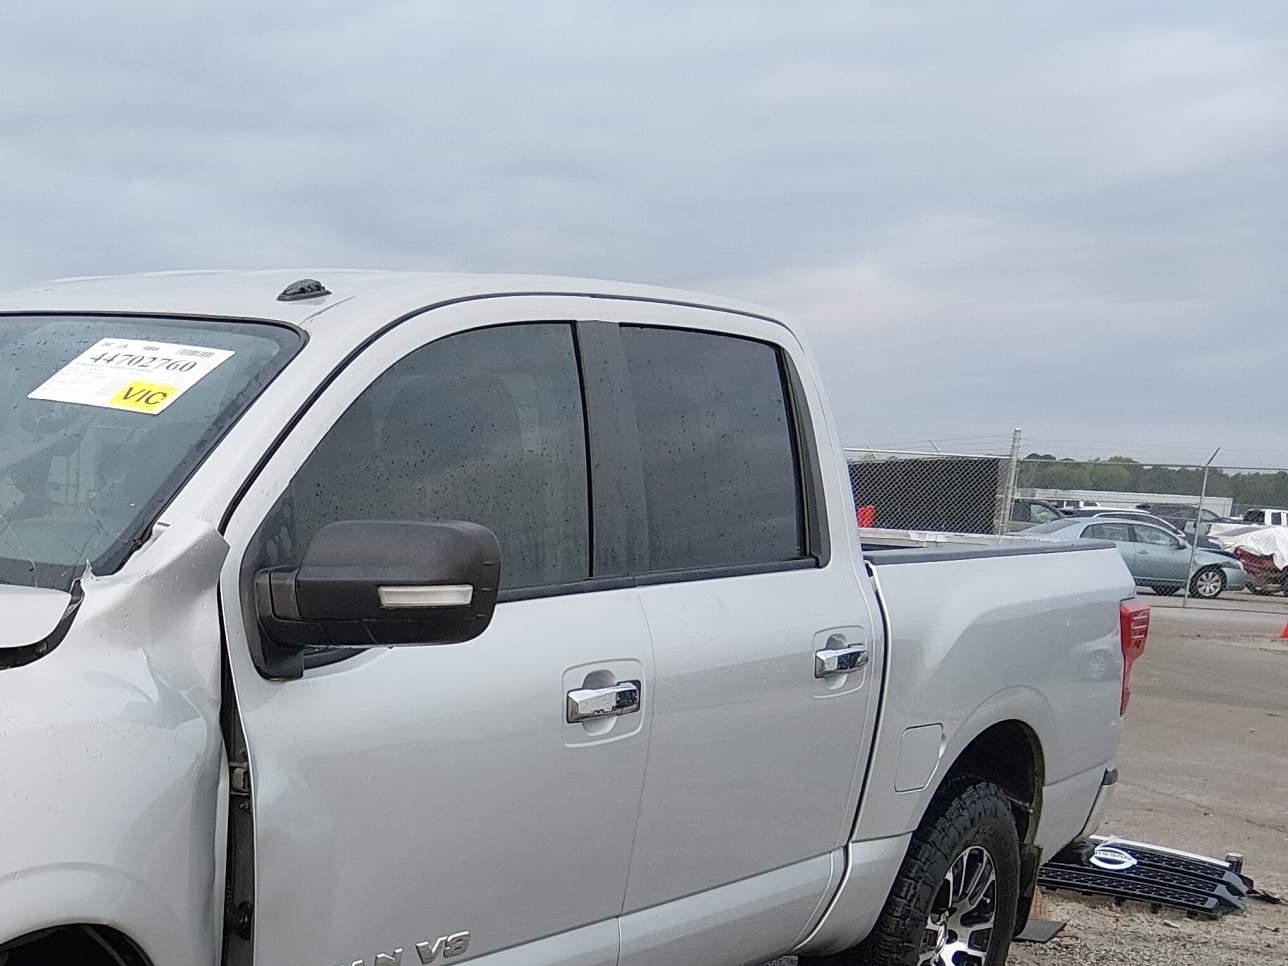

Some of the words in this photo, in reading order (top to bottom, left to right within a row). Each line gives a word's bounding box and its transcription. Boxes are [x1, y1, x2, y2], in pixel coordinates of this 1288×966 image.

[90, 351, 198, 374] 44702760
[121, 386, 168, 406] VIC
[415, 930, 471, 966] V8
